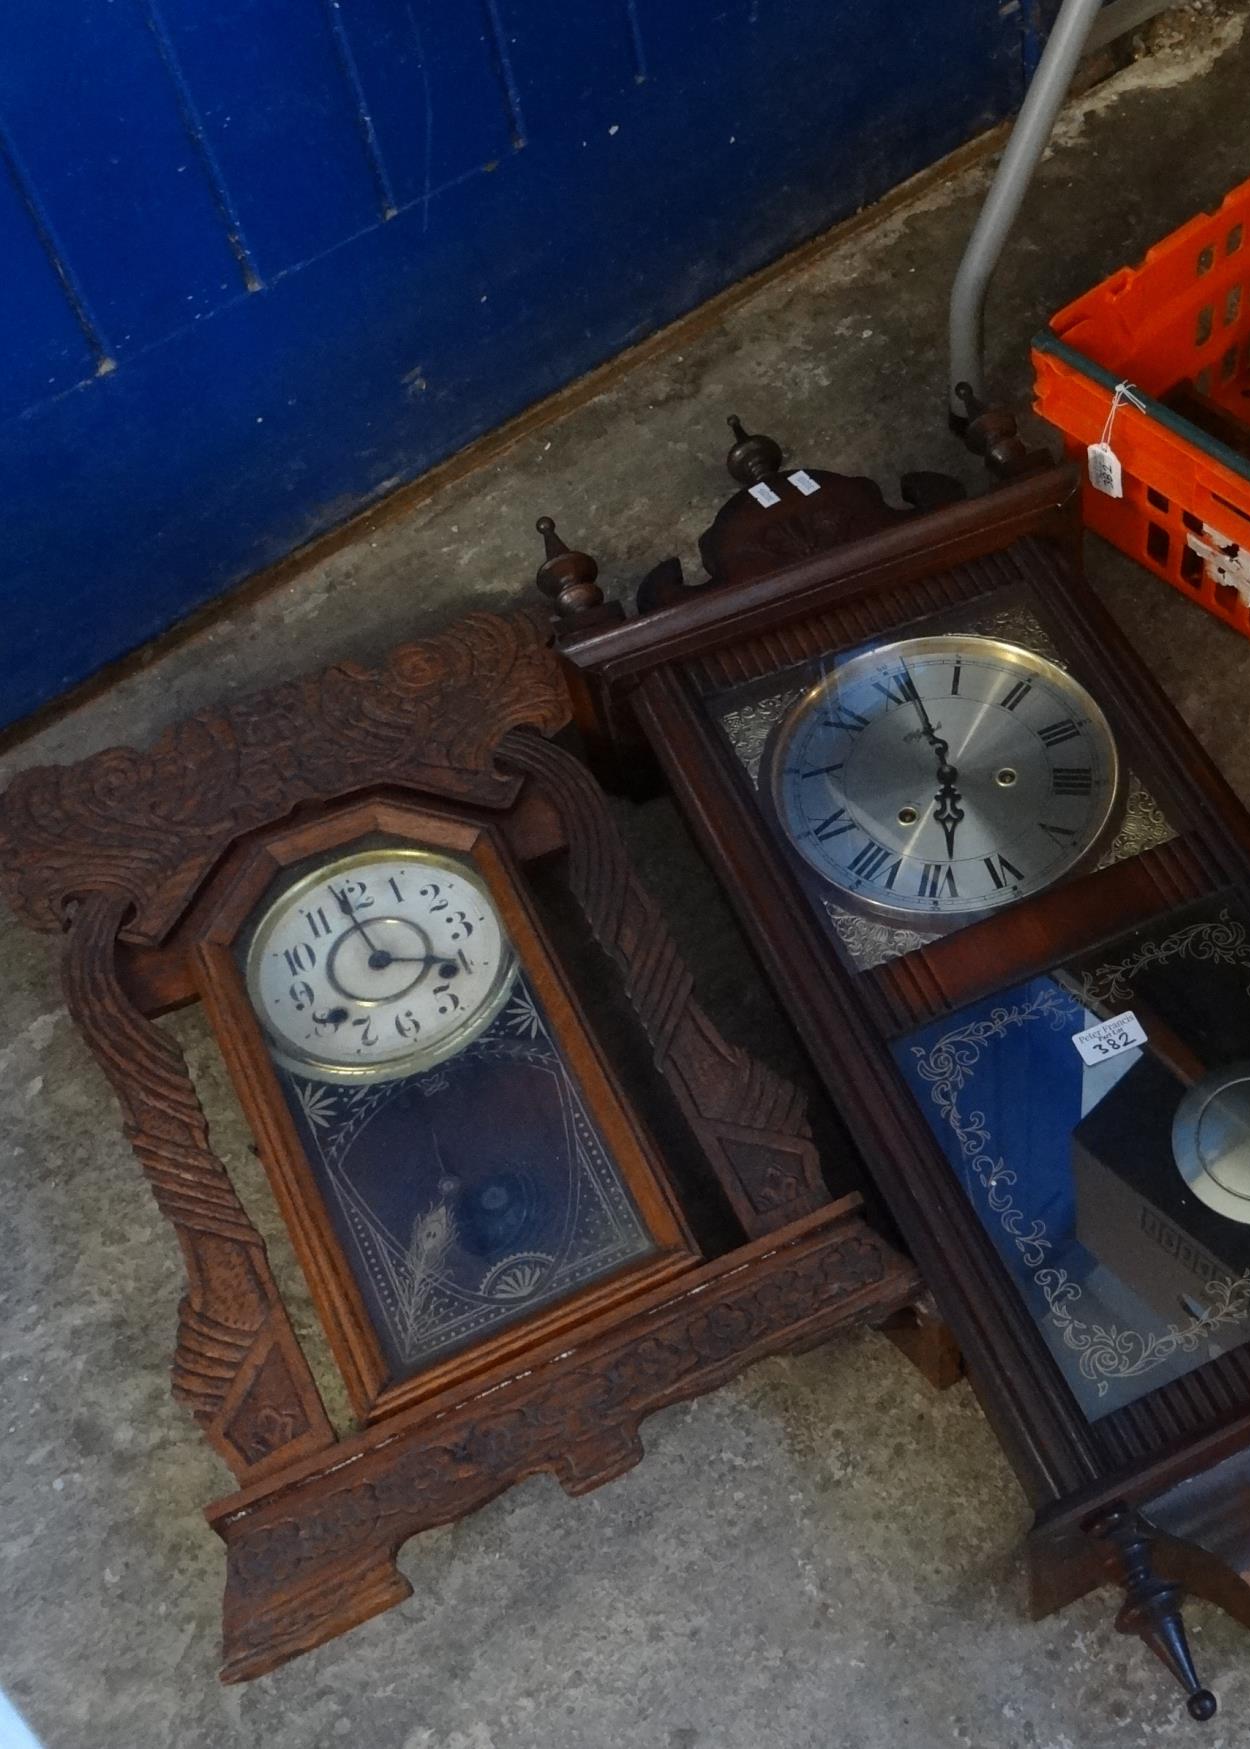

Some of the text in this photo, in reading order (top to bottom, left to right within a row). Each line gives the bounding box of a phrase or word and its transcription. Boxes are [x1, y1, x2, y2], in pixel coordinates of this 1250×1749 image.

[1001, 681, 1032, 711] II
[1036, 718, 1081, 749] III
[1052, 767, 1092, 796] IIII
[847, 839, 904, 890] VIII
[388, 876, 403, 903] 1
[917, 863, 960, 898] VII
[419, 883, 449, 913] 2
[304, 906, 332, 938] 11
[445, 910, 474, 941] 3
[283, 941, 317, 977] 10
[288, 980, 315, 1012] 9
[432, 984, 461, 1015] 5
[351, 1014, 380, 1047] 7
[394, 1010, 421, 1038] 6
[1078, 1013, 1135, 1044] Peter Francis
[1092, 1031, 1137, 1054] 382
